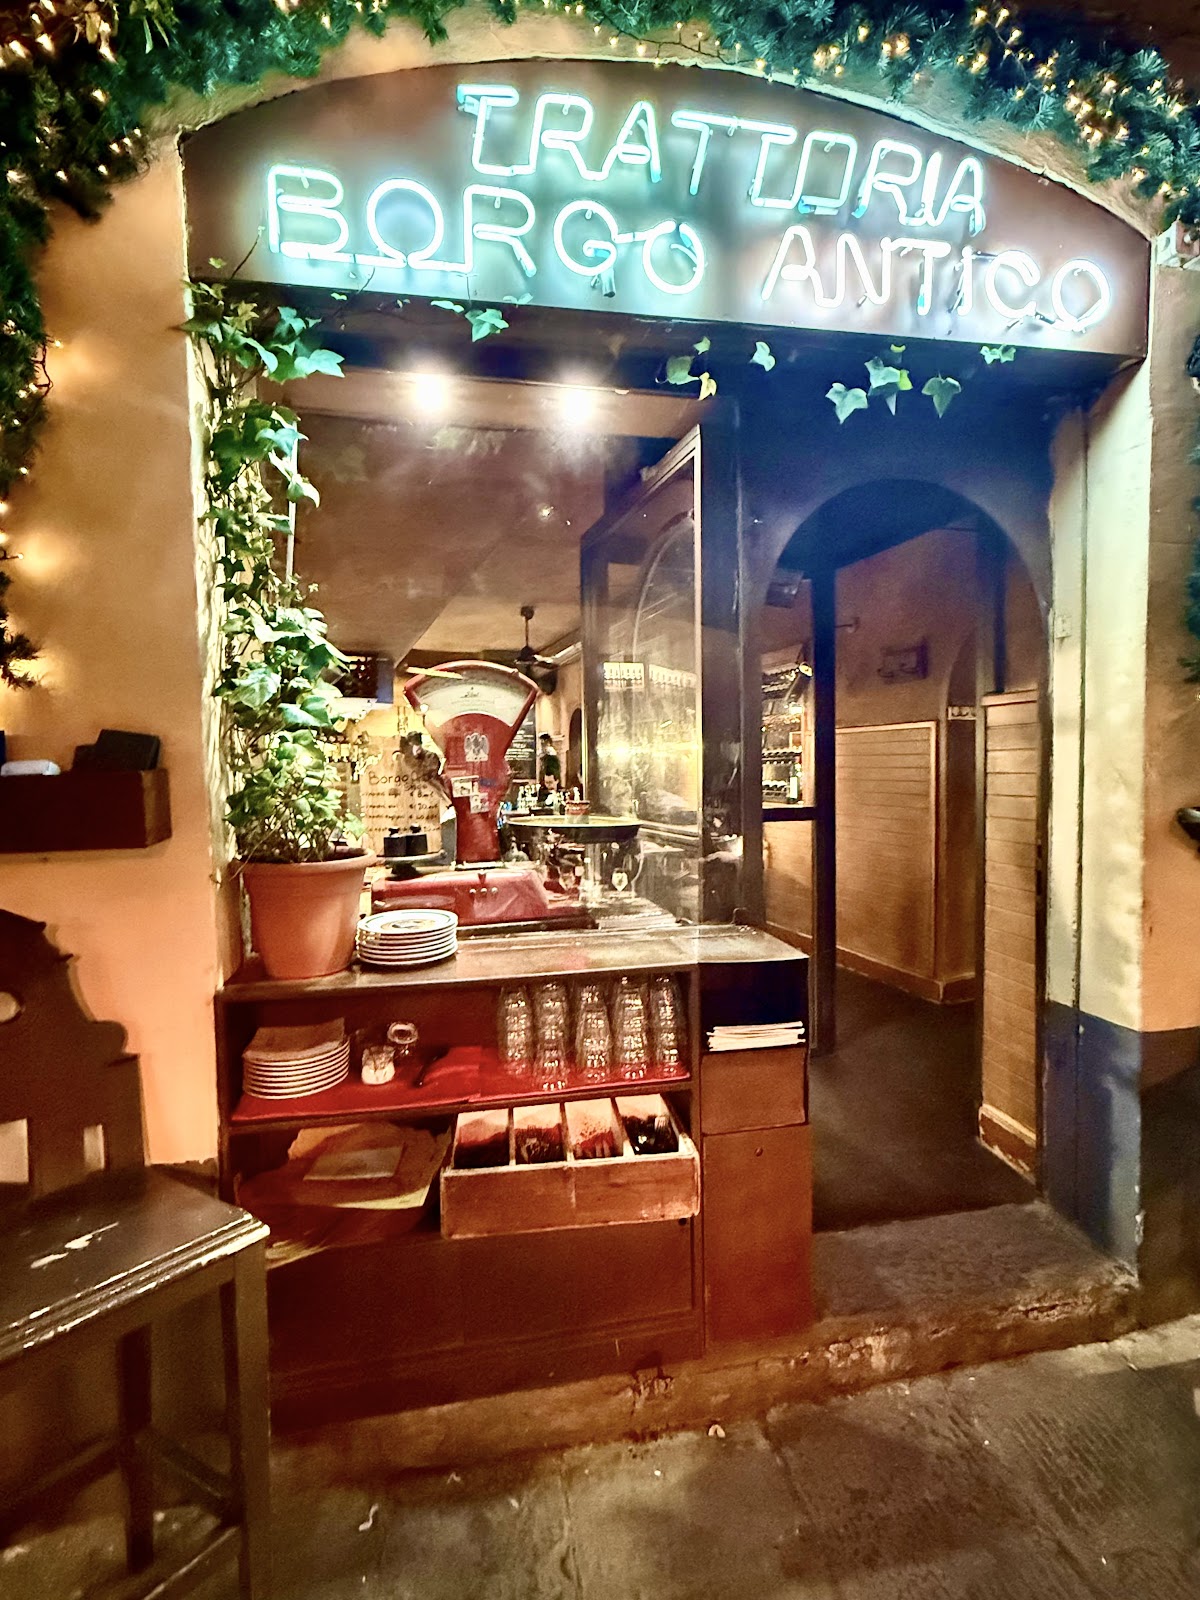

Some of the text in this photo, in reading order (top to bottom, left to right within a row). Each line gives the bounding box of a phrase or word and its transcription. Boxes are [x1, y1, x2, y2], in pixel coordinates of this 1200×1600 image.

[457, 83, 986, 235] TRATTORIA
[267, 163, 1112, 332] BORGO ANTICO
[368, 771, 409, 787] Borgo
